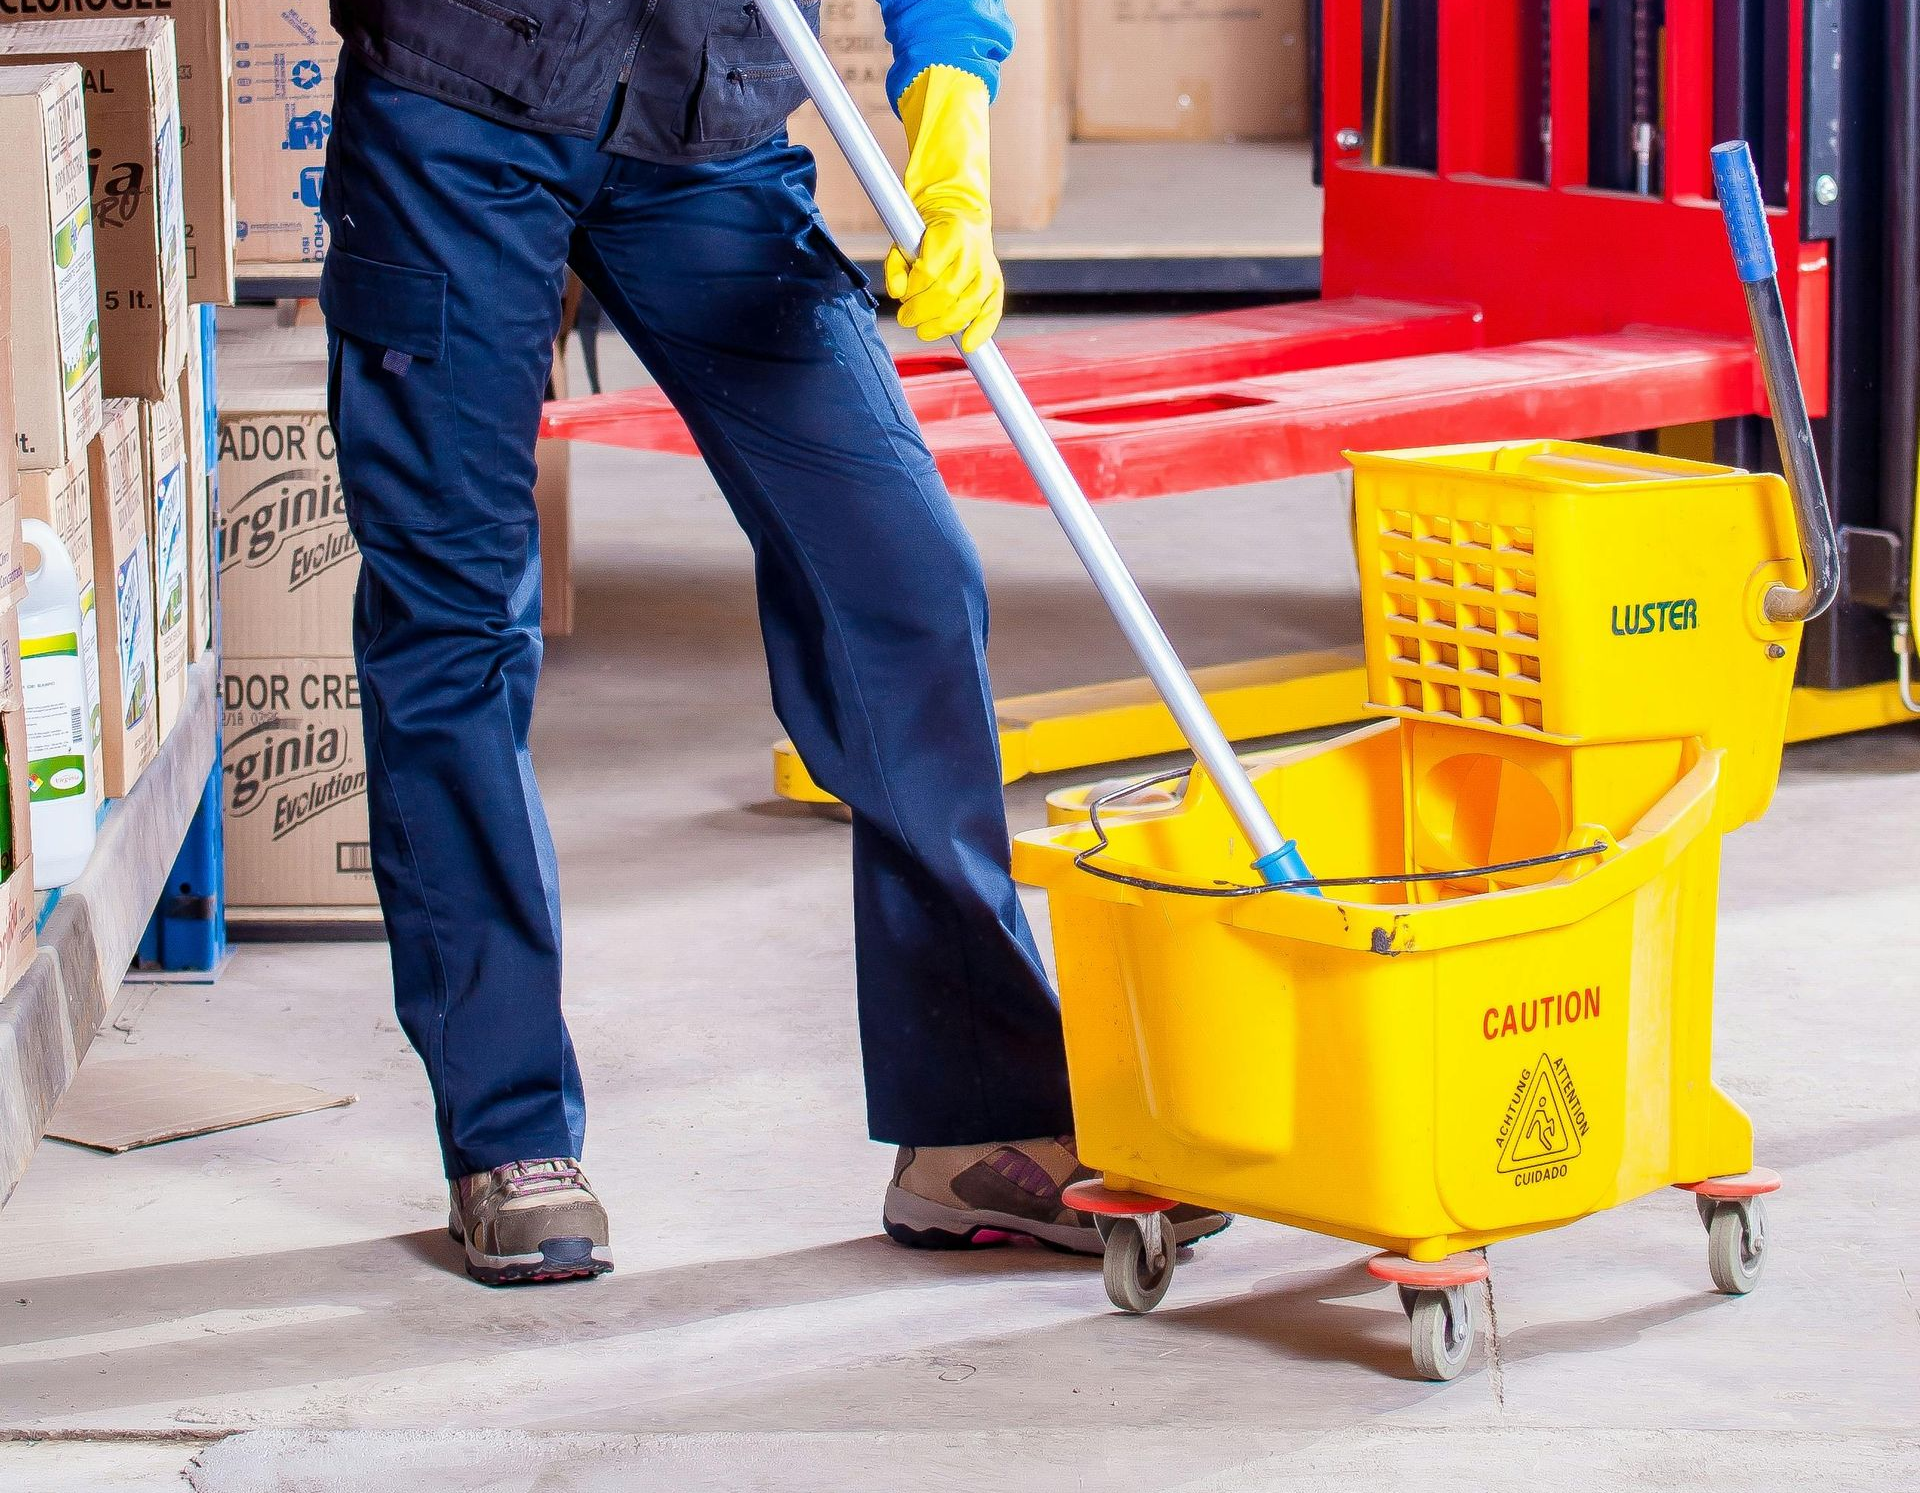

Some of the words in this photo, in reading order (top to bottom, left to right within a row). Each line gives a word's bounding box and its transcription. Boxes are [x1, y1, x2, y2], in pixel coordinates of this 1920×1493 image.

[105, 291, 120, 311] 5
[1611, 598, 1697, 636] LUSTER
[300, 674, 361, 710] CRE
[273, 772, 366, 834] Evolution
[1482, 985, 1601, 1041] CAUTION
[1495, 1068, 1532, 1149] ACHTUNG
[1553, 1057, 1590, 1138] ATTENTION
[1514, 1163, 1569, 1188] CUIDADO
